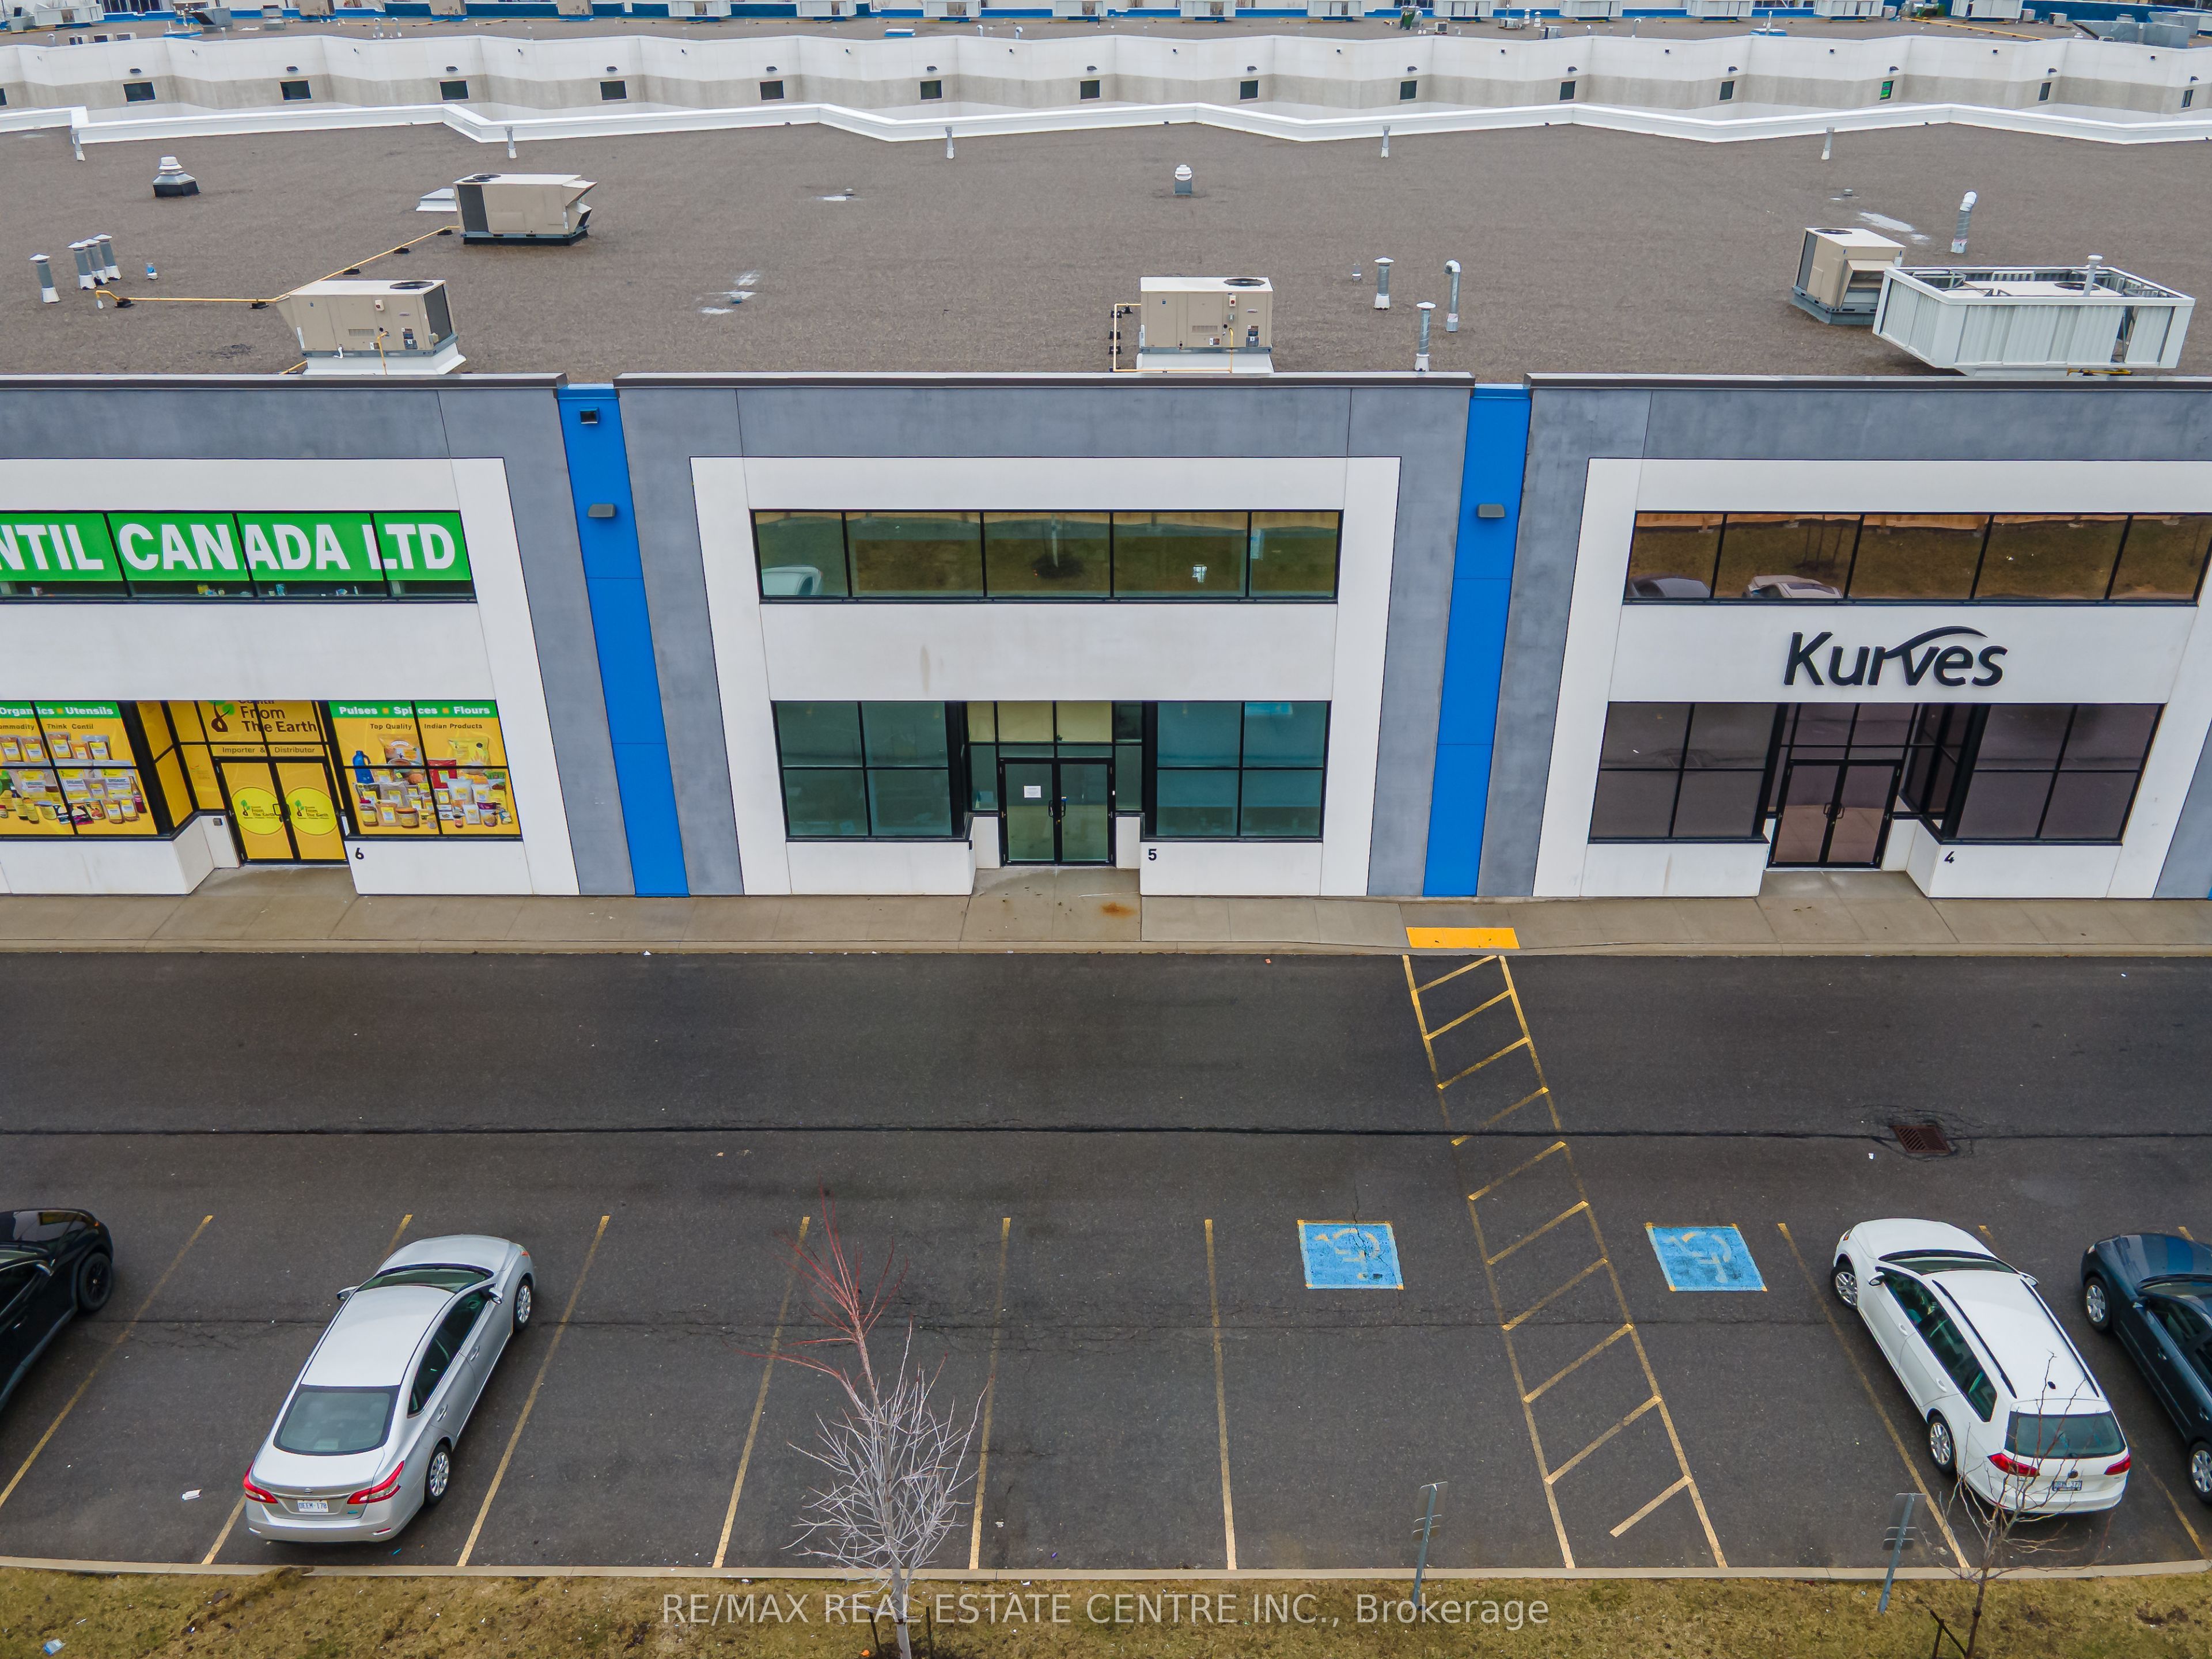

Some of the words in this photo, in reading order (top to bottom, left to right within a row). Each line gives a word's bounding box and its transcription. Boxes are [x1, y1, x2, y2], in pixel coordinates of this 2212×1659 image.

[119, 523, 351, 570] CANADA
[362, 524, 456, 570] LTD
[1783, 626, 2008, 687] Kurves
[0, 707, 54, 716] Organics
[65, 707, 113, 715] Utensils
[240, 706, 286, 719] From
[393, 707, 438, 716] Spices
[453, 706, 490, 714] Flours
[241, 721, 272, 732] The
[275, 721, 317, 732] Earth
[355, 847, 365, 860] 6
[1148, 848, 1157, 861] 5
[1944, 851, 1955, 863] 4
